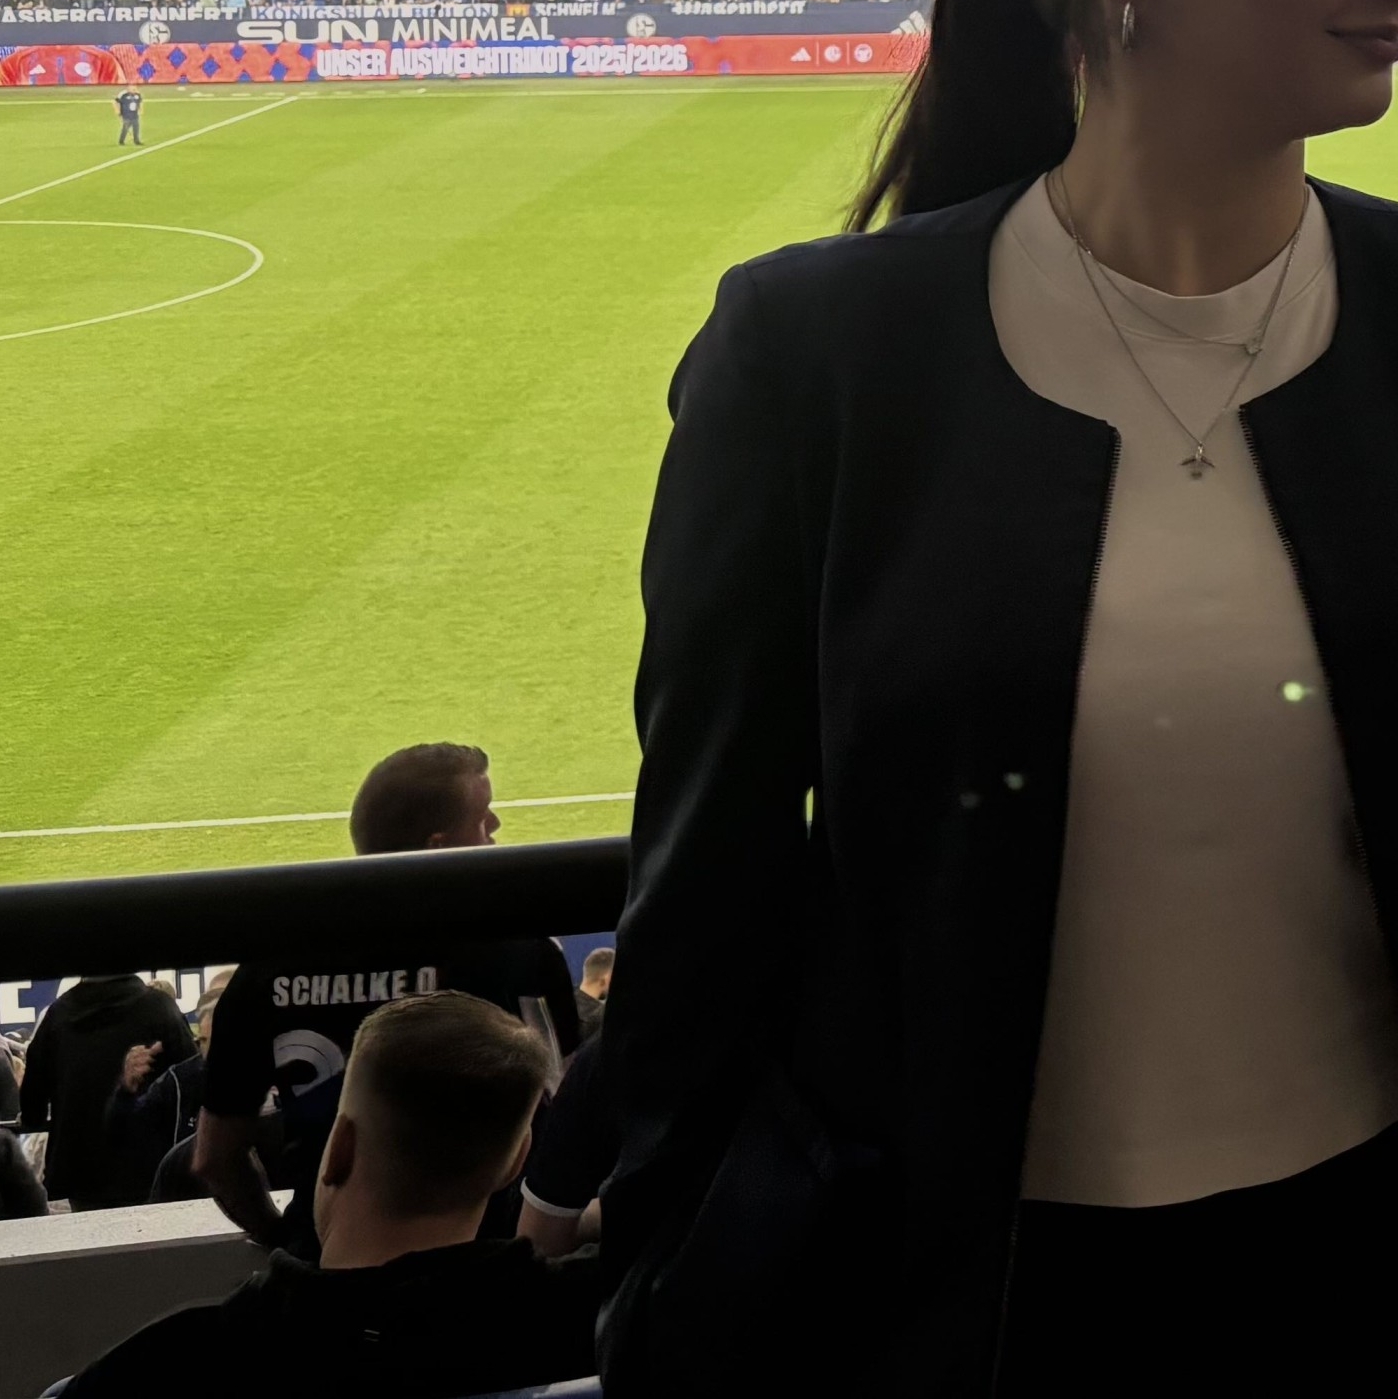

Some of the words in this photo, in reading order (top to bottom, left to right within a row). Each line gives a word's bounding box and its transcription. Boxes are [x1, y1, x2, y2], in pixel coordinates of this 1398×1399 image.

[237, 20, 378, 45] SUN
[392, 17, 555, 42] MINIMEAL
[316, 48, 386, 76] UNSER
[390, 46, 569, 75] AUSWEICHTRIKOT
[572, 43, 688, 74] 2025/2026
[272, 971, 407, 1008] SCHALKE
